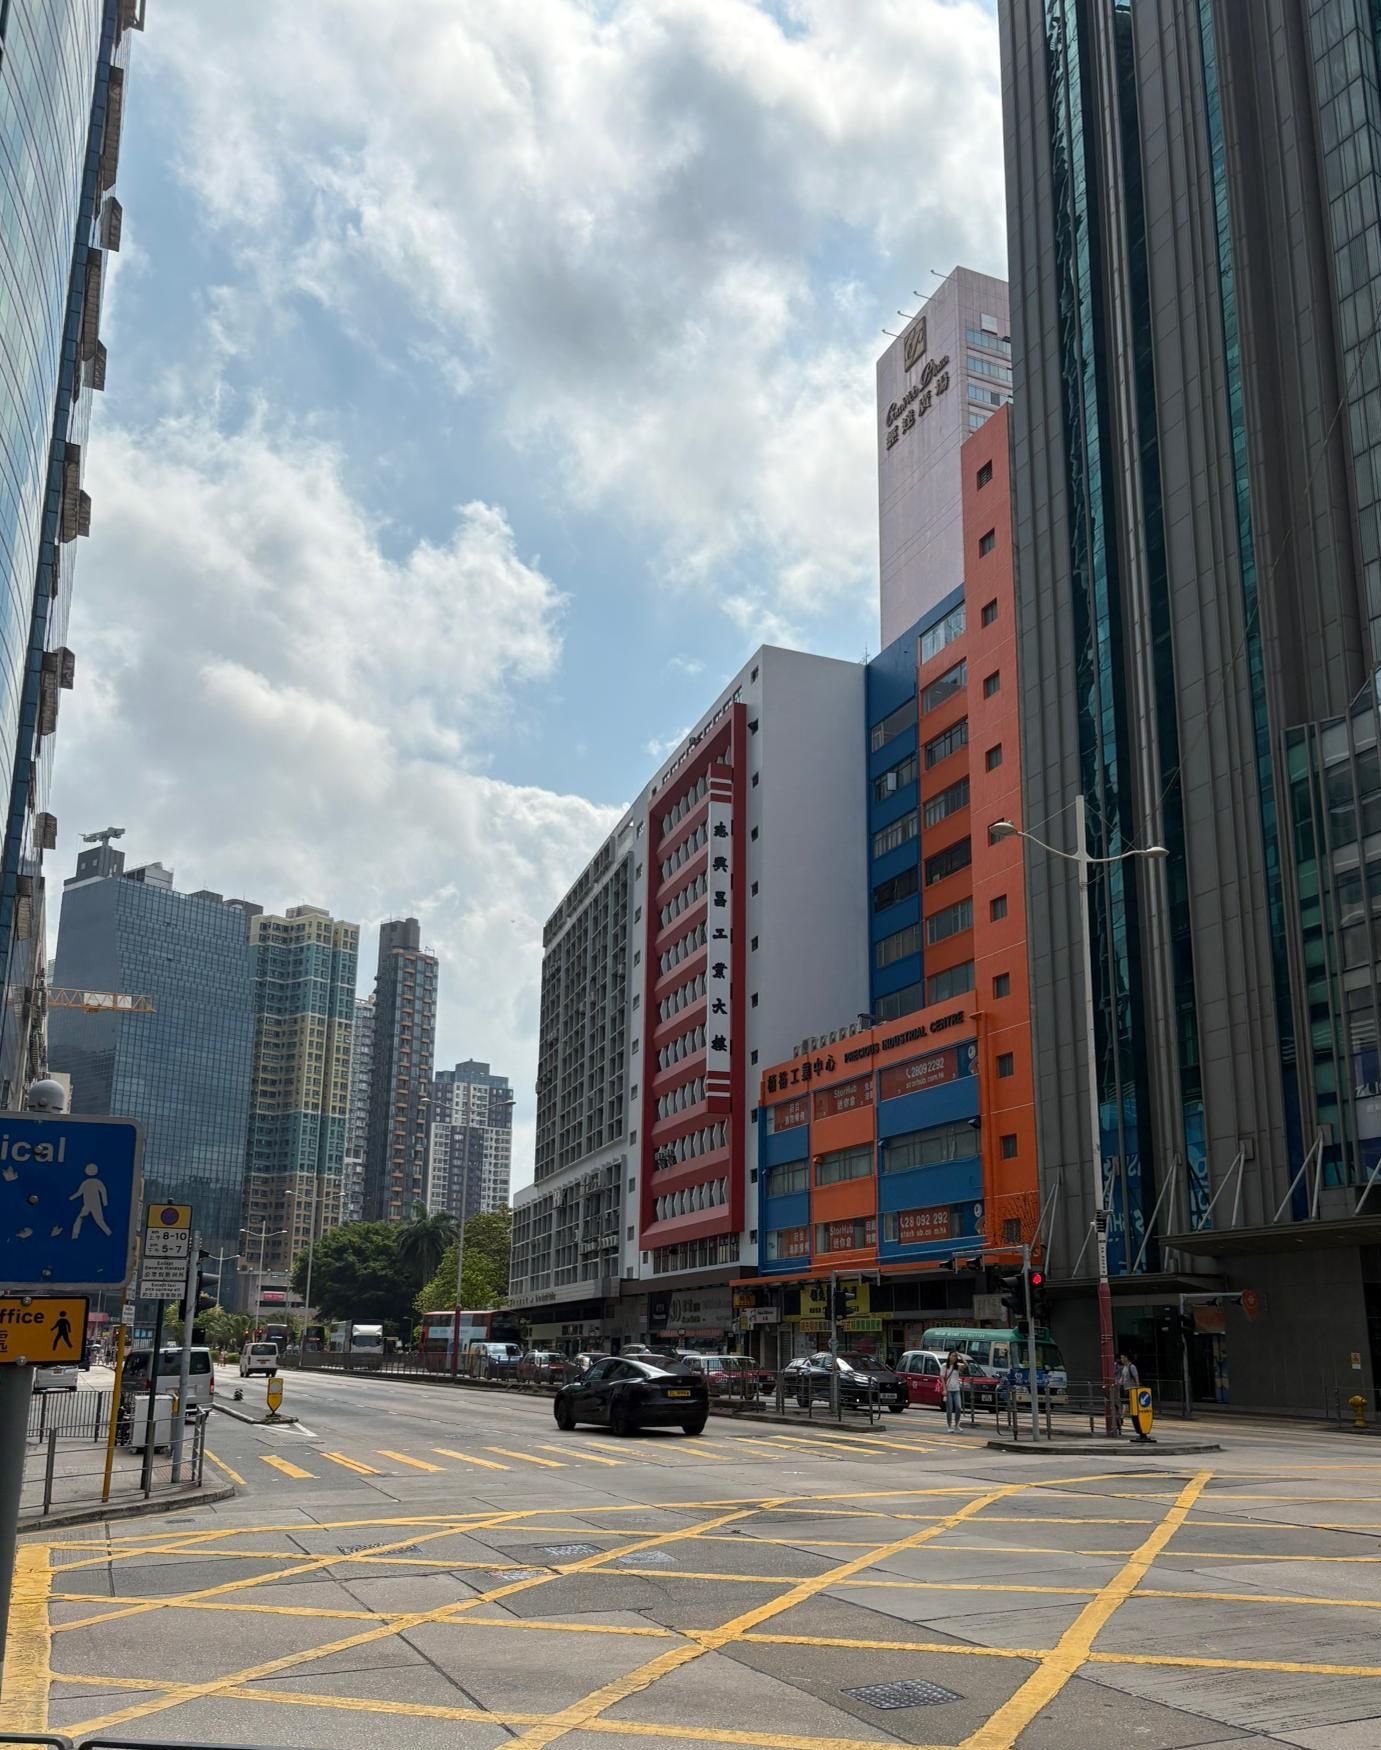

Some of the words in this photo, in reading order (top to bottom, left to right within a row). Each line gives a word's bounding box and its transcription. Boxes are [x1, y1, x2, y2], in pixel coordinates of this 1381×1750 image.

[843, 1042, 880, 1064] PRECIOUS
[882, 1025, 928, 1051] INDUSTRIAL
[929, 1010, 965, 1031] CENTRE
[833, 1085, 857, 1099] StorHub
[829, 1222, 854, 1236] StorHub
